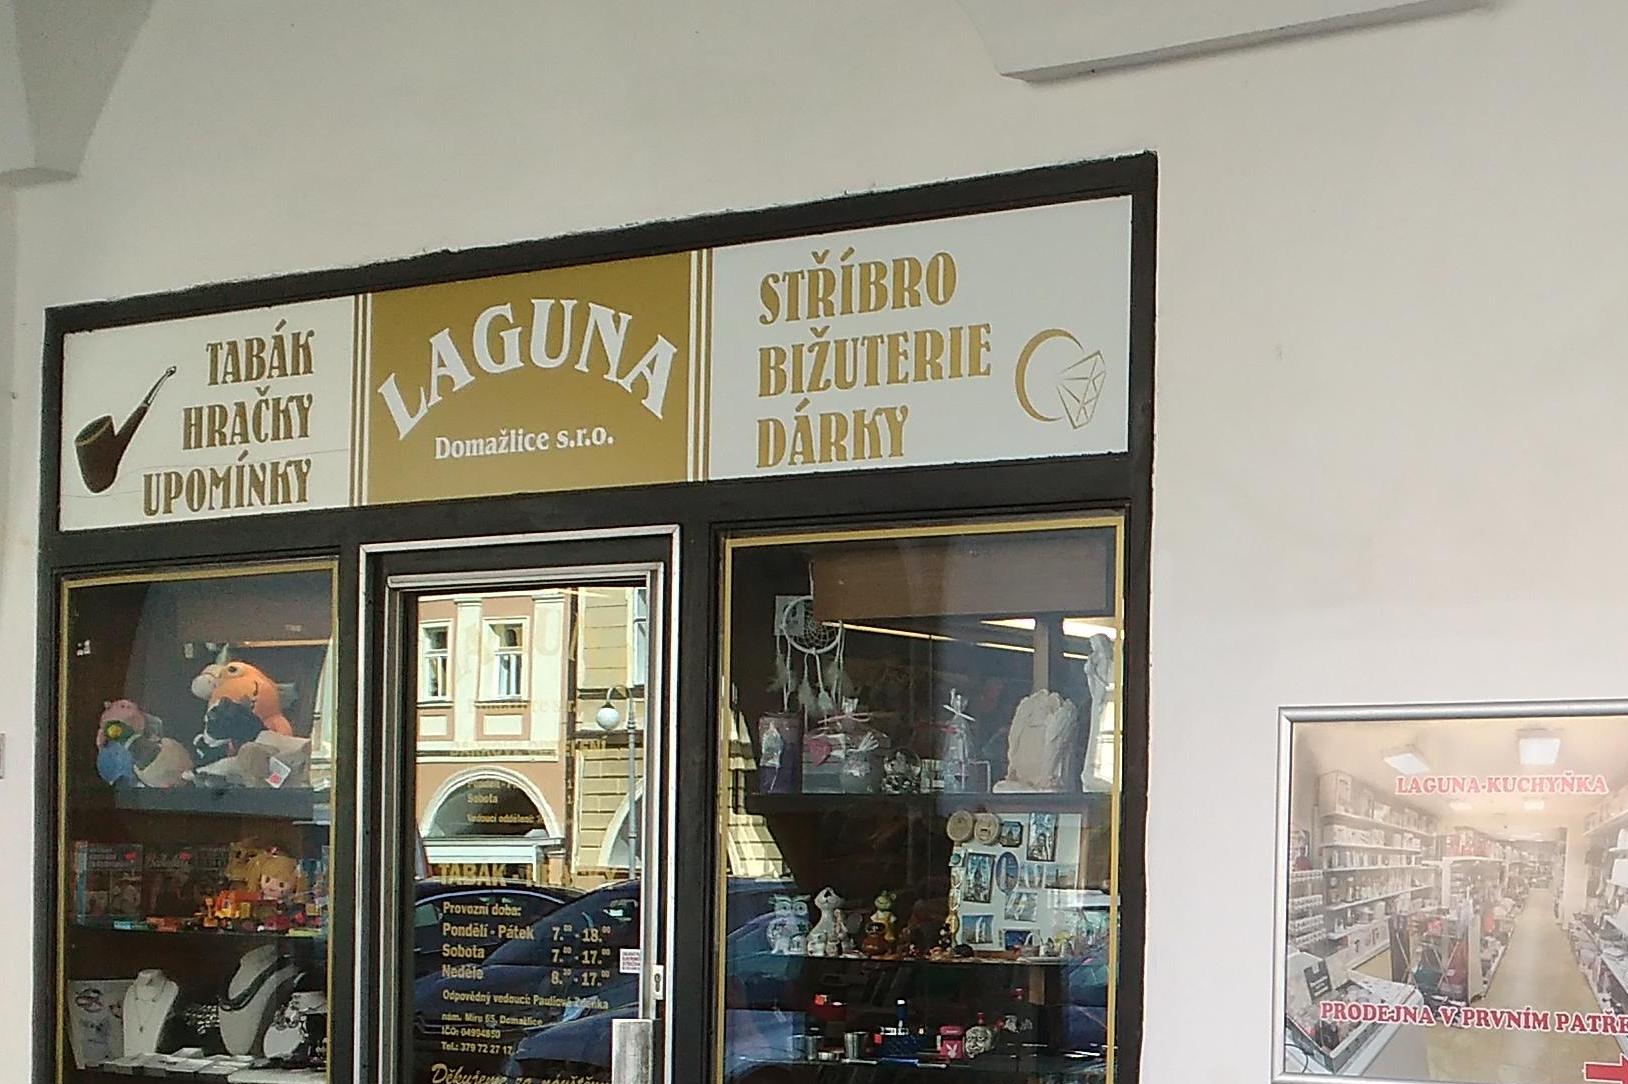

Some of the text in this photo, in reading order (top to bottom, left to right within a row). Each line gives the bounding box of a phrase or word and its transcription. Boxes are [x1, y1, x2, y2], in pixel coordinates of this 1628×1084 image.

[758, 246, 957, 327] STŘÍBRO
[205, 322, 314, 388] TABÁK
[377, 298, 678, 440] LAGUNA
[757, 321, 992, 400] BIŽUTERIE
[182, 393, 312, 451] HRAČKY
[434, 426, 615, 460] Domažlice s.r.o.
[755, 401, 910, 470] DÁRKY
[142, 455, 310, 517] UPOMÍNKY
[1395, 772, 1608, 795] LAGUNA-KUCHYŇKA
[442, 922, 488, 938] Pondělí
[497, 924, 535, 940] Pátek
[443, 901, 522, 917] Provozní doba:
[441, 964, 485, 980] Neděle
[442, 944, 485, 959] Sobota
[1320, 1001, 1436, 1026] PRODEJNA
[1440, 1006, 1462, 1026] V
[1462, 1006, 1549, 1033] PRVNÍM
